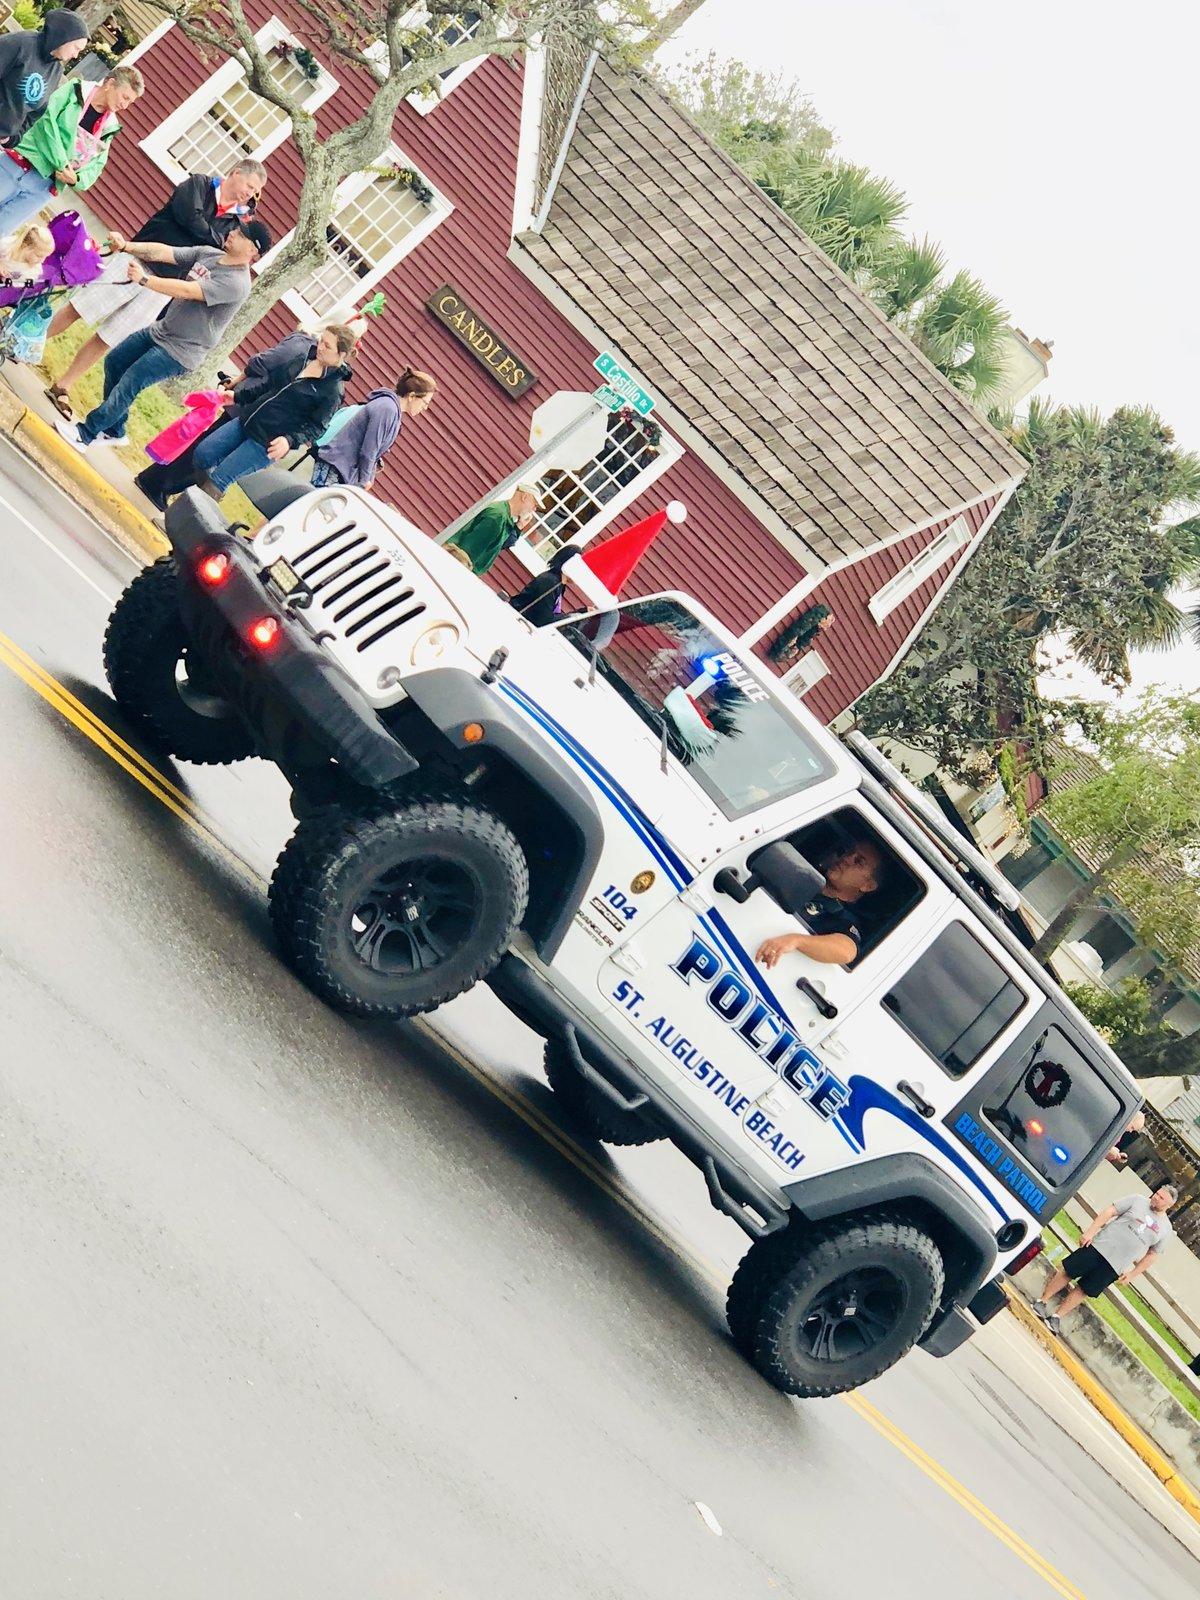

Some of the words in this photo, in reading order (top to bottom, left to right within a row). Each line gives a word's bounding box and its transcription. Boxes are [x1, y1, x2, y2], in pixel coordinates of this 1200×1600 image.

[440, 296, 525, 386] CANDLES
[600, 358, 609, 367] S
[607, 365, 641, 401] Castillo
[711, 652, 770, 703] POLICE
[575, 909, 614, 948] RANGLER
[602, 885, 638, 920] 104
[669, 931, 851, 1122] POLICE
[612, 980, 645, 1018] ST.
[645, 1016, 751, 1117] AUGUSTINE
[745, 1110, 806, 1170] BEACH
[954, 1111, 1003, 1166] BEACH
[997, 1156, 1048, 1215] PATROL
